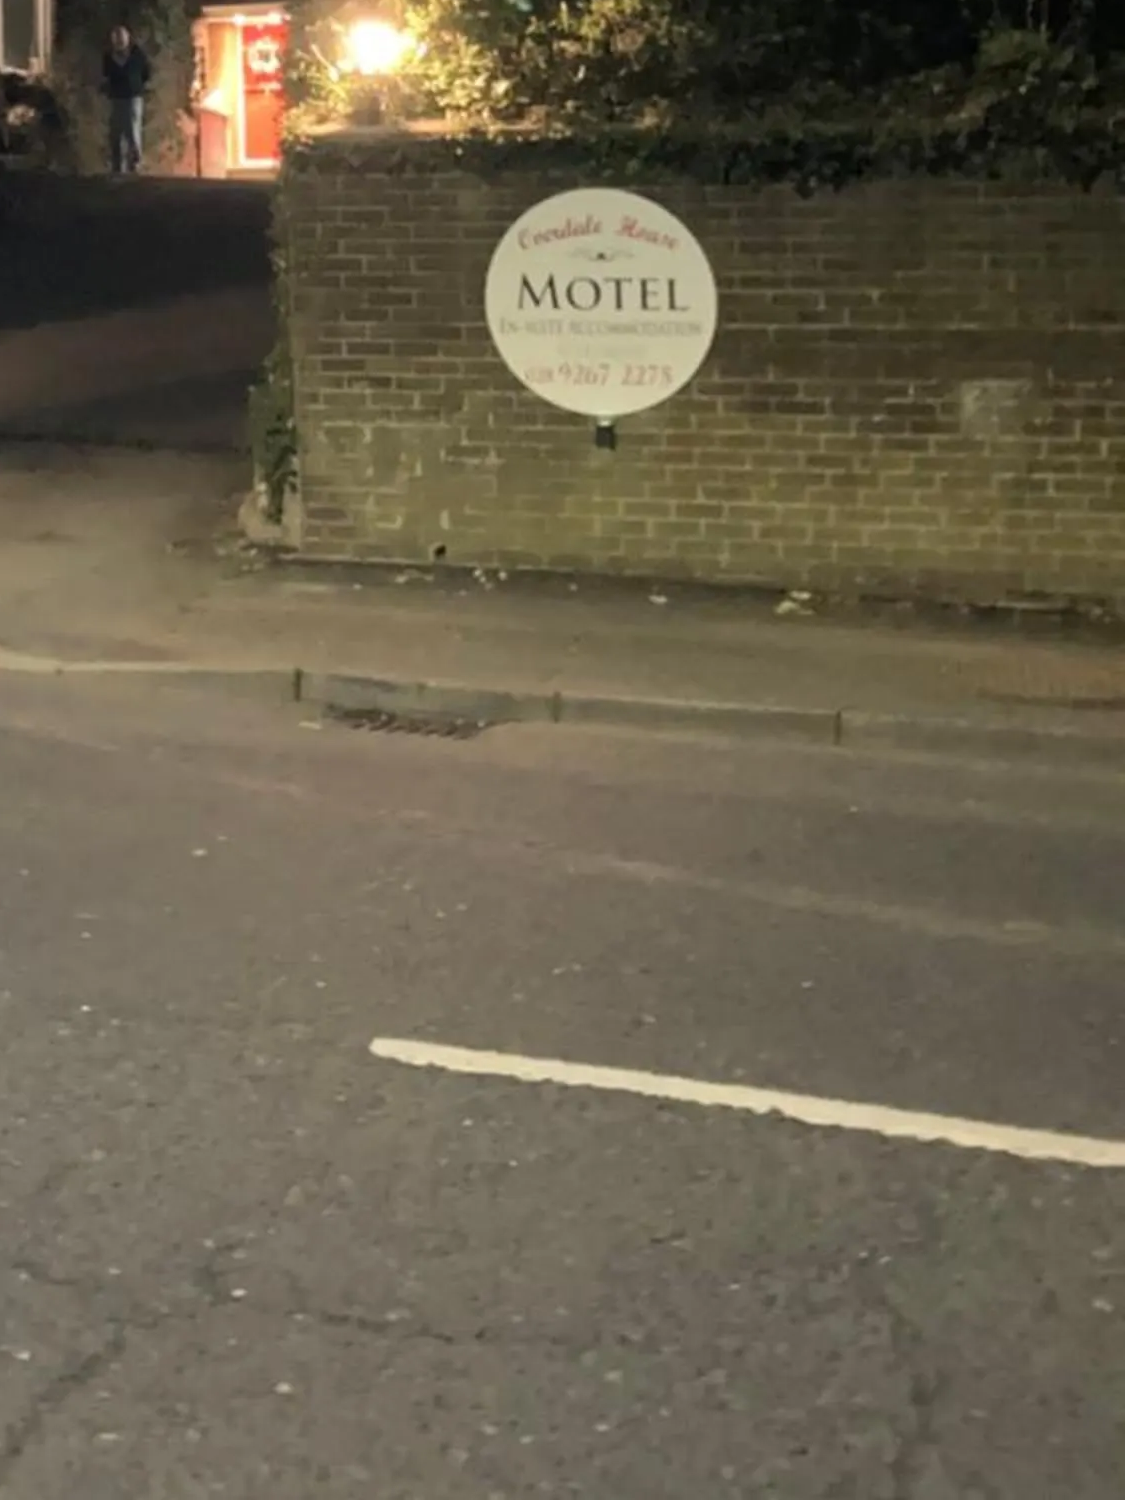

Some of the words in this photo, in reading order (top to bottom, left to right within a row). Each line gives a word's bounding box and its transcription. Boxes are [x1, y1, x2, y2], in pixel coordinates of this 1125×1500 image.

[613, 214, 681, 250] House
[517, 273, 691, 311] MOTEL
[558, 362, 611, 387] 9267
